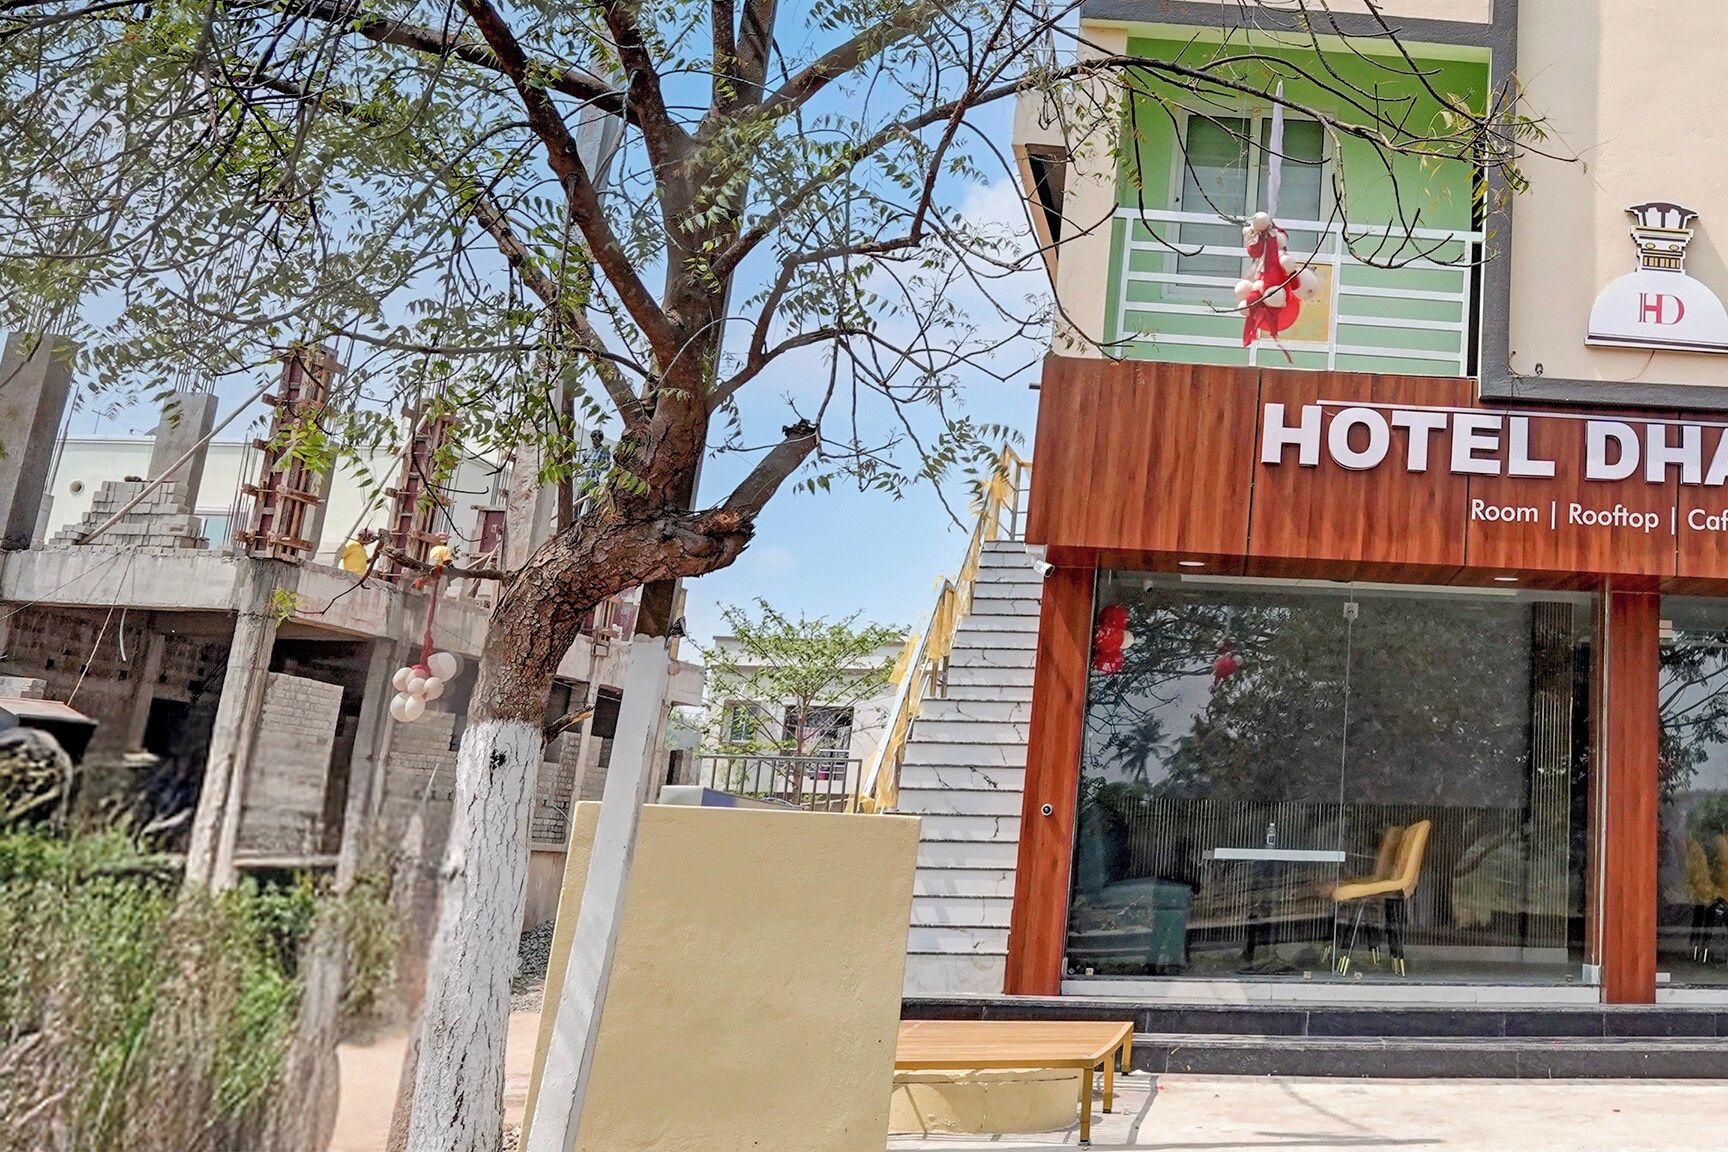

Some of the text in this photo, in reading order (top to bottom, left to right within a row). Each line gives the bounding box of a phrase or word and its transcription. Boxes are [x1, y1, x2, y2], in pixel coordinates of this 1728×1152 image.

[1637, 292, 1685, 325] HD
[1261, 403, 1556, 477] HOTEL
[1471, 498, 1538, 523] Room
[1569, 503, 1659, 533] Rooftop
